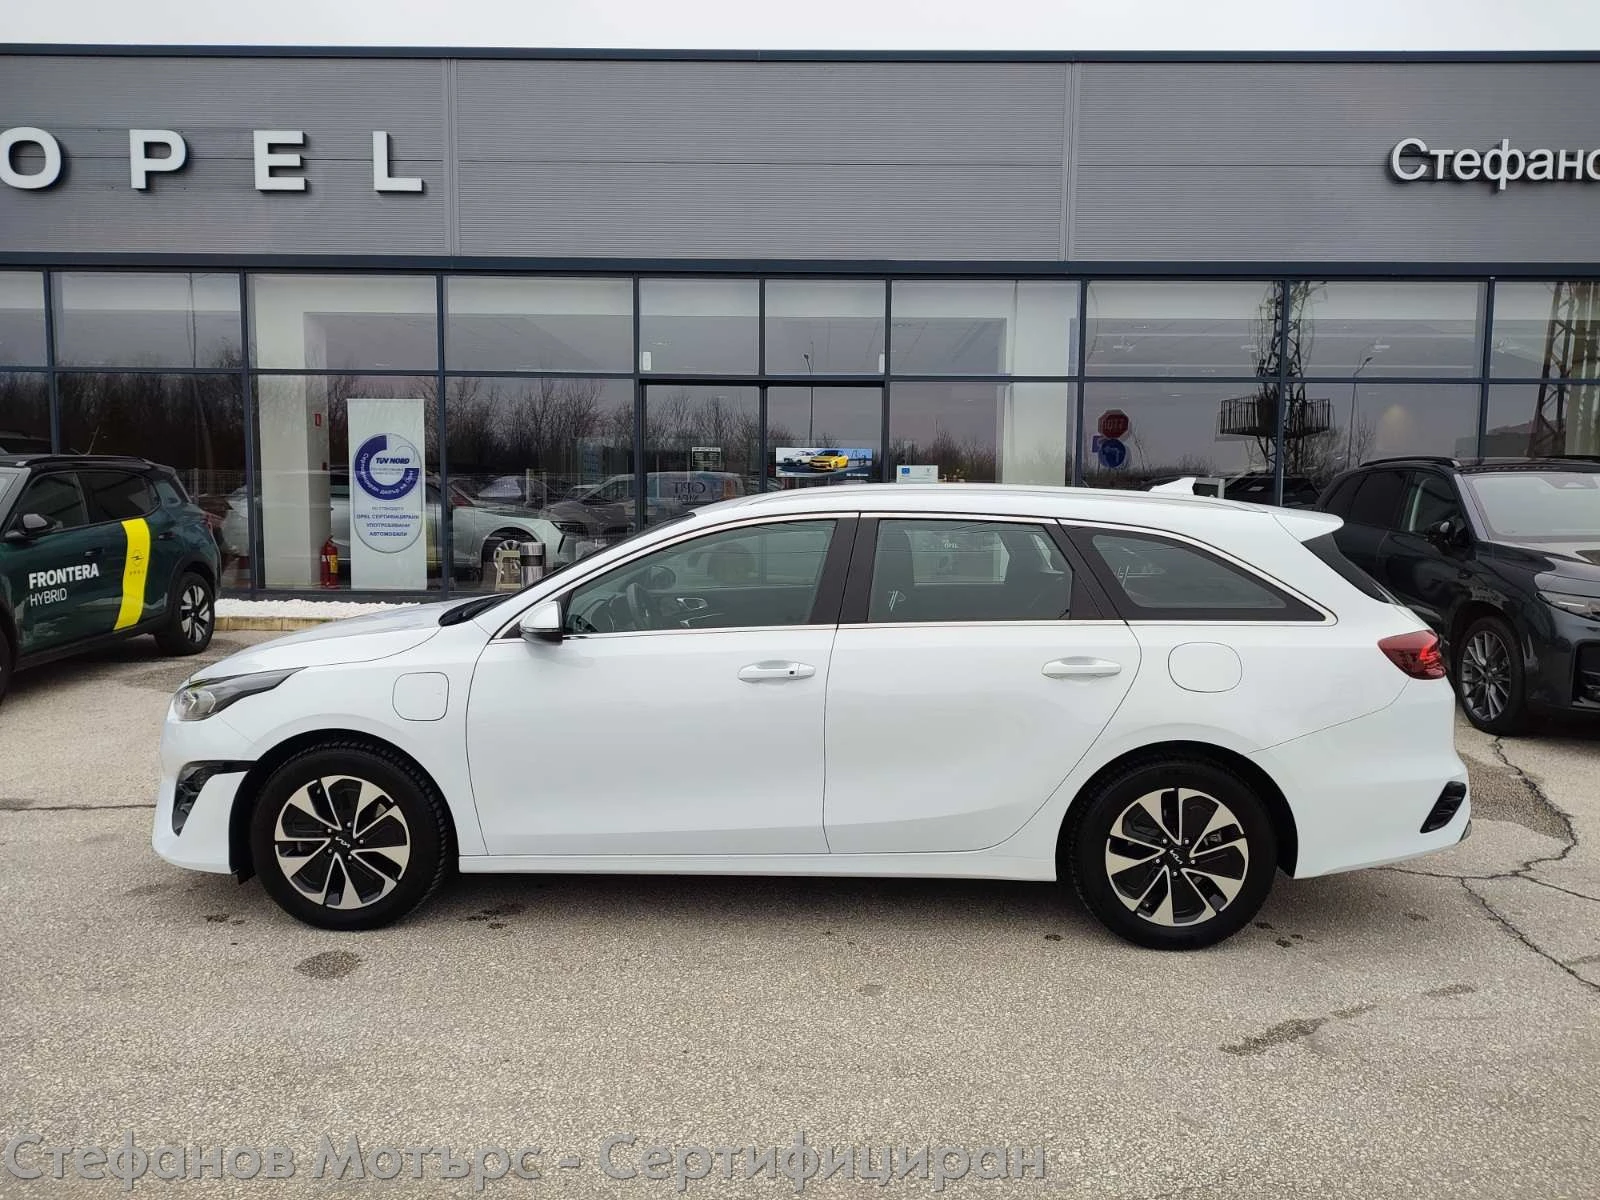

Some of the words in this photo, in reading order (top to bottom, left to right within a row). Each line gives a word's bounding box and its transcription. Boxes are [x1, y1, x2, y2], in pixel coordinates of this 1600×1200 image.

[0, 127, 424, 193] OPEL
[389, 457, 410, 465] NORD
[28, 563, 99, 590] FRONTERA
[30, 588, 68, 607] HYBRID
